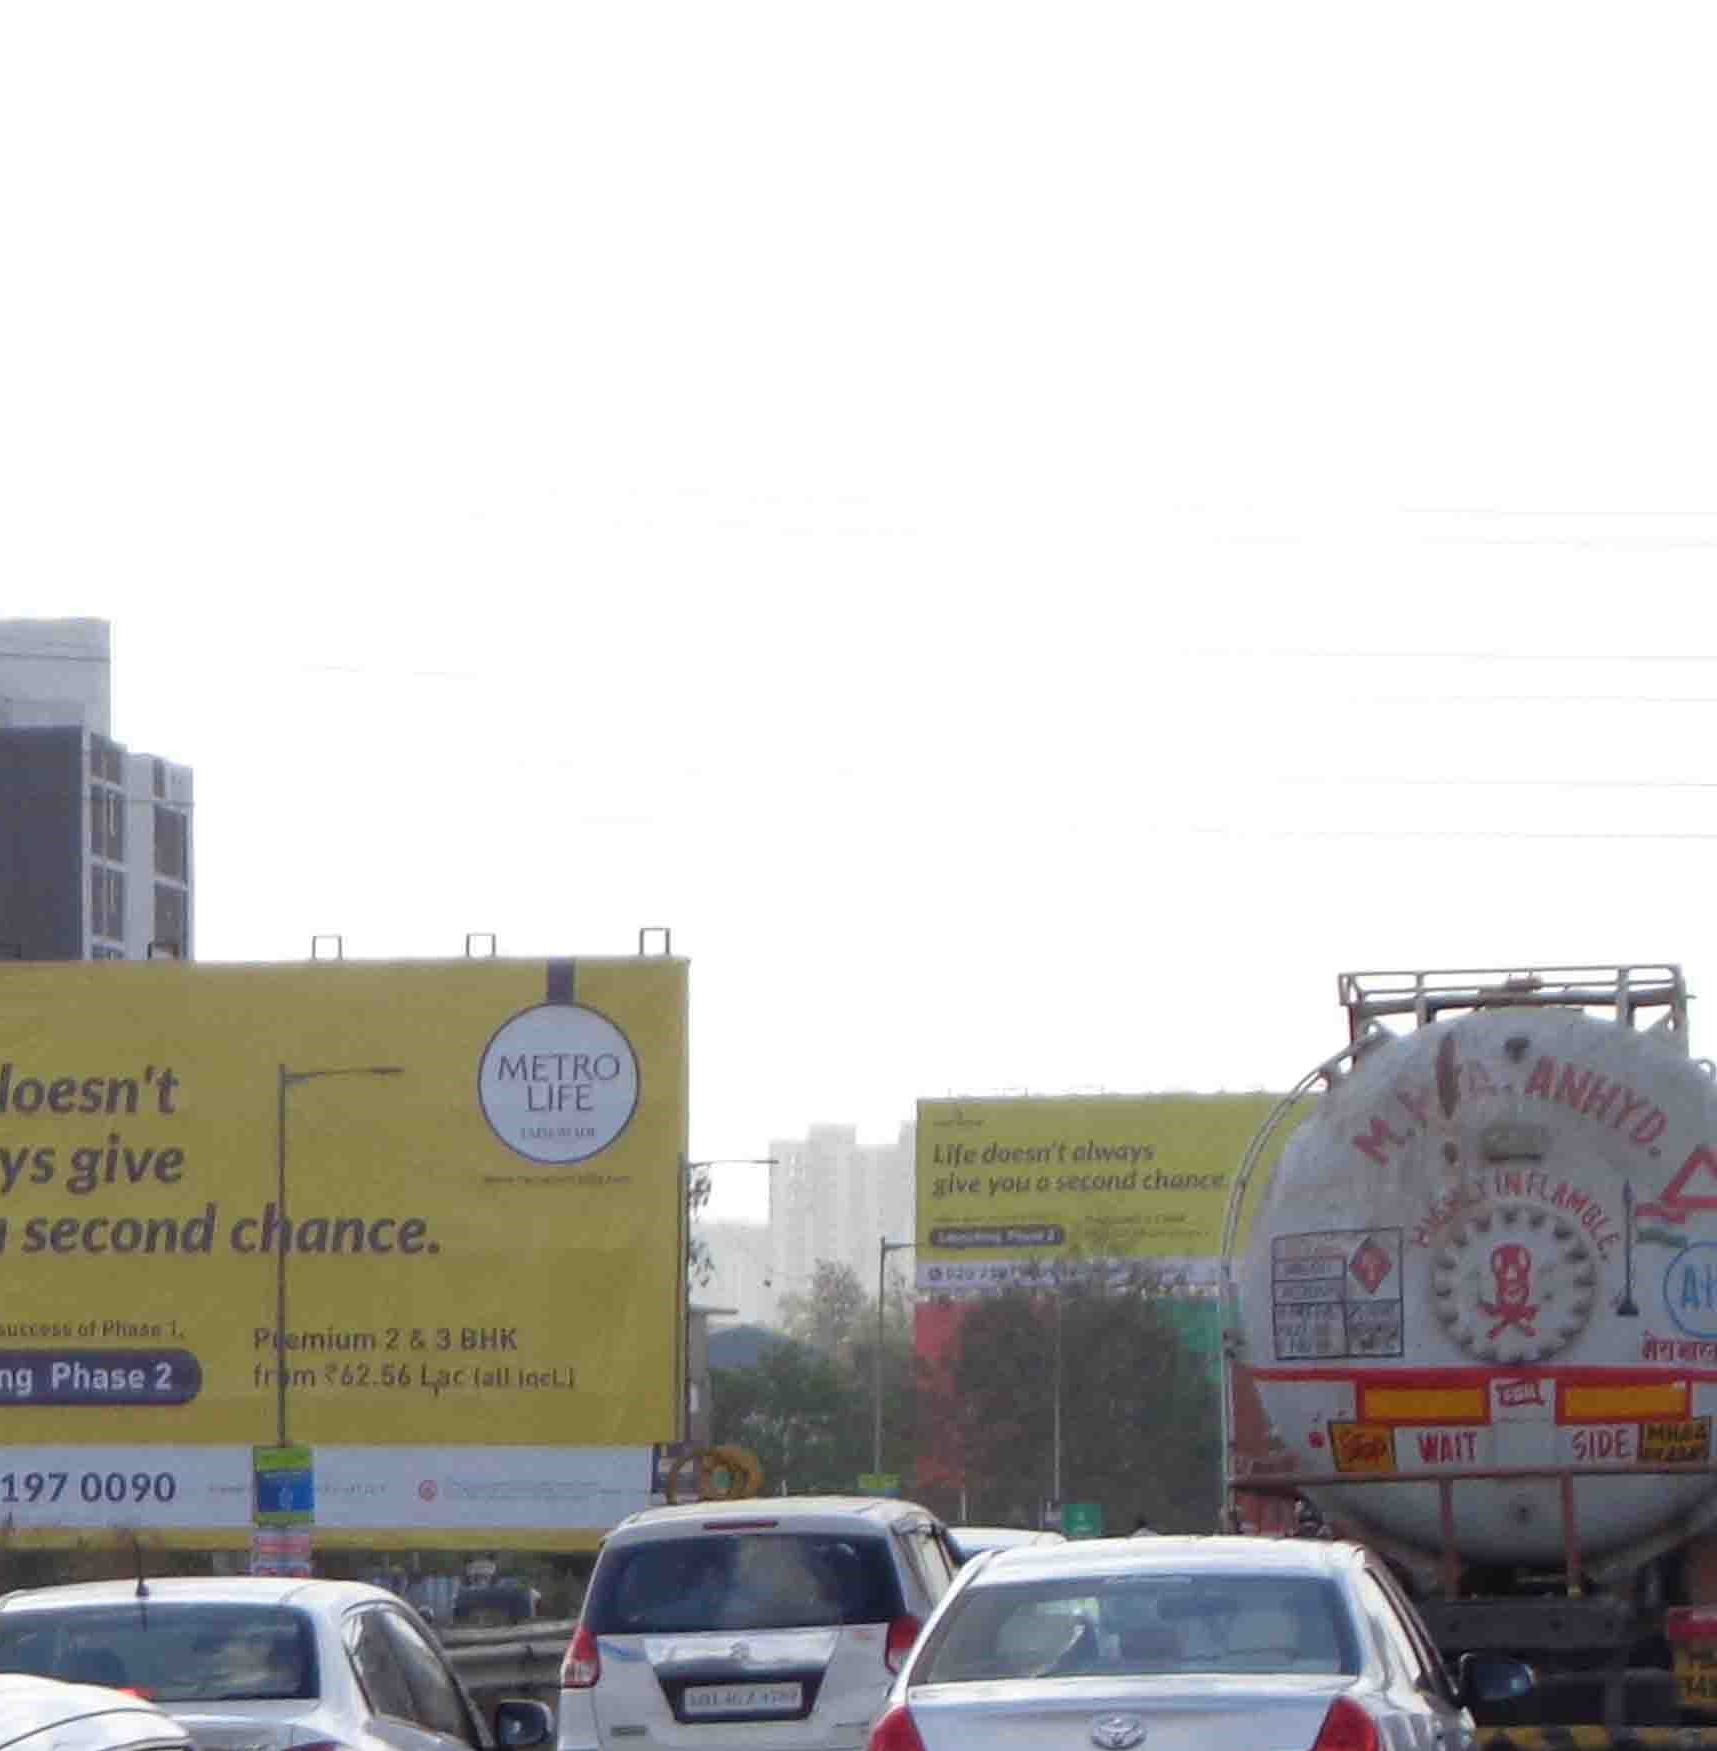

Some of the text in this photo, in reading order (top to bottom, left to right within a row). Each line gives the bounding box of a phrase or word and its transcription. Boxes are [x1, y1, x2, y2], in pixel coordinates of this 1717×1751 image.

[498, 1053, 621, 1082] METRO
[526, 1084, 594, 1112] LIFE
[66, 1133, 185, 1195] give
[933, 1140, 1155, 1168] Life doesn't always
[932, 1172, 981, 1199] give
[988, 1174, 1030, 1198] you
[1056, 1171, 1135, 1194] second
[22, 1201, 218, 1254] second
[229, 1200, 441, 1255] chance.
[101, 1319, 159, 1337] Phase
[385, 1328, 400, 1350] 2
[410, 1328, 426, 1350] &
[436, 1328, 452, 1350] 3
[460, 1328, 518, 1350] BHK
[51, 1361, 145, 1390] Phase
[155, 1362, 173, 1390] 2
[420, 1367, 464, 1389] Lac
[1419, 1430, 1477, 1464] WAIT
[1572, 1427, 1631, 1460] SIDE
[80, 1472, 177, 1502] 0090
